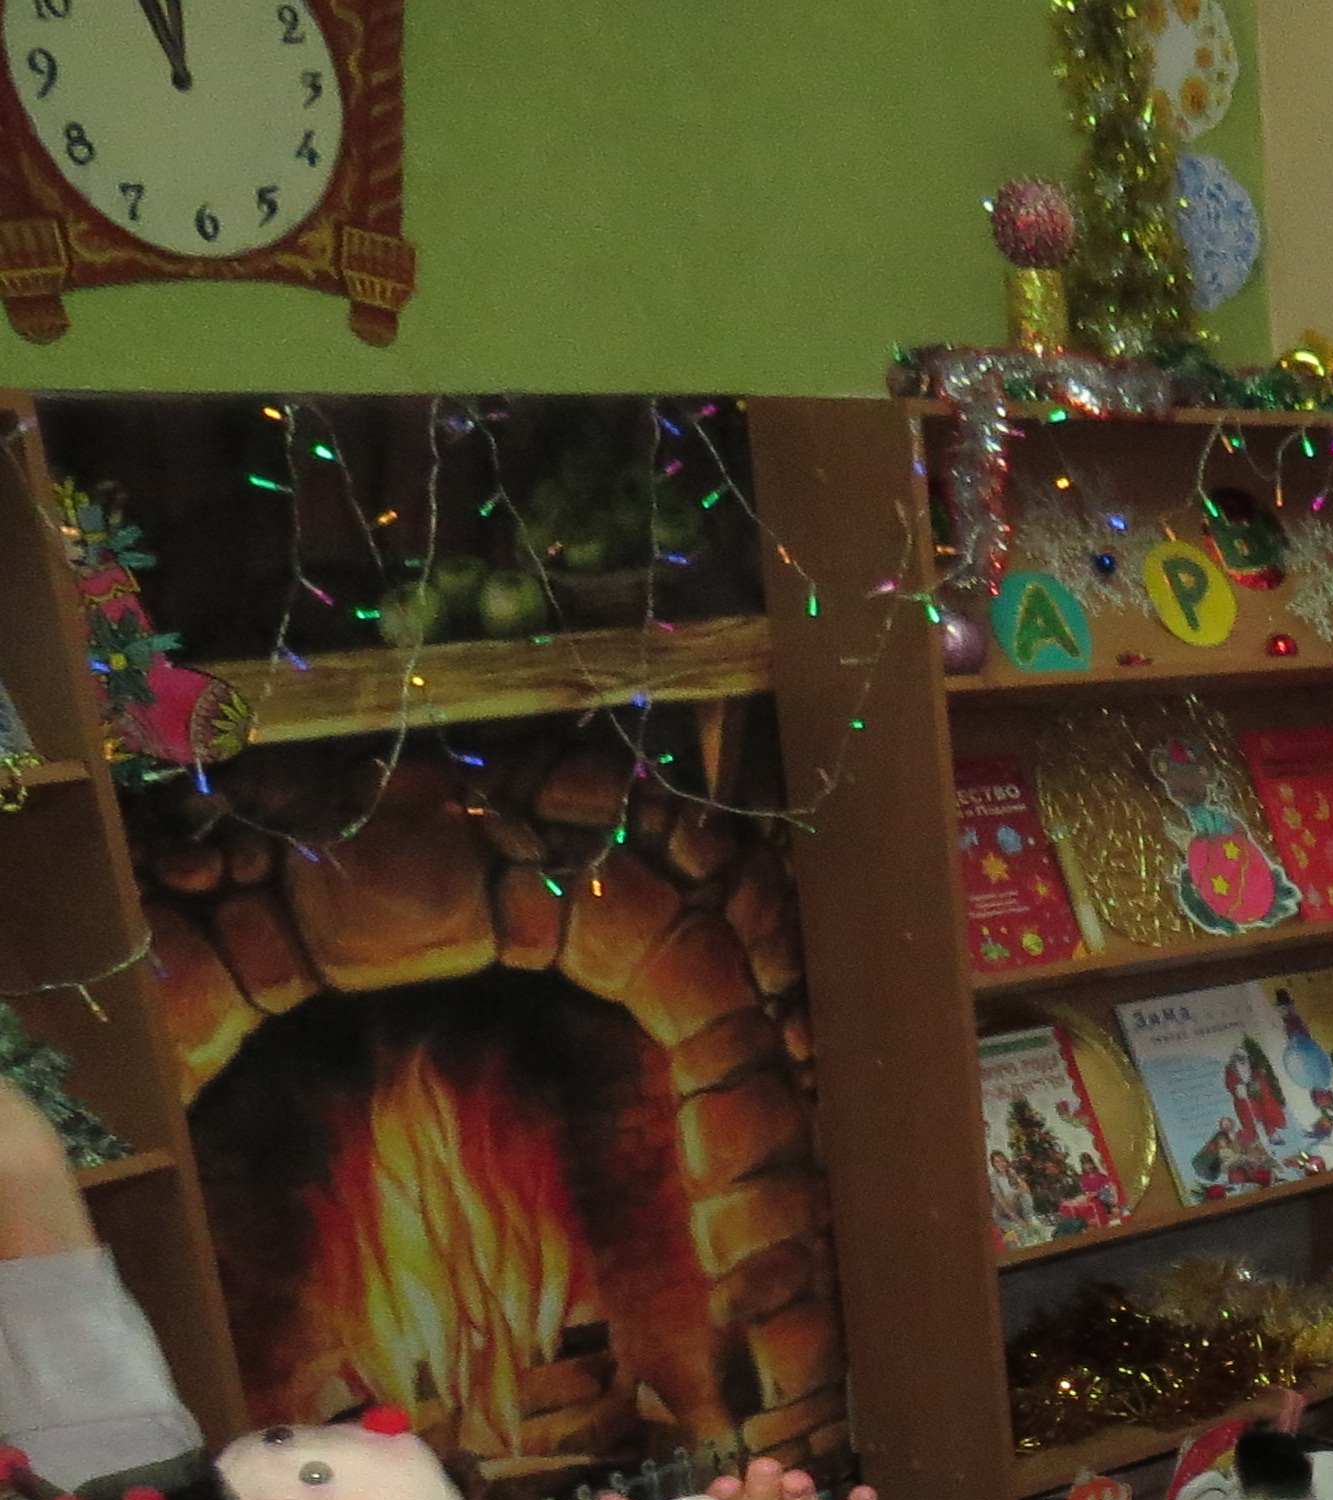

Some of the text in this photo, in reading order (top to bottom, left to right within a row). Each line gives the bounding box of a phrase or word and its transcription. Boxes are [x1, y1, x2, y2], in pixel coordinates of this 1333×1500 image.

[277, 5, 304, 44] 2
[28, 48, 57, 99] 9
[301, 71, 322, 108] 3
[65, 122, 95, 166] 8
[296, 130, 321, 167] 4
[119, 182, 144, 221] 7
[256, 186, 279, 228] 5
[195, 203, 220, 242] 6
[957, 784, 1020, 805] ЕСТВО
